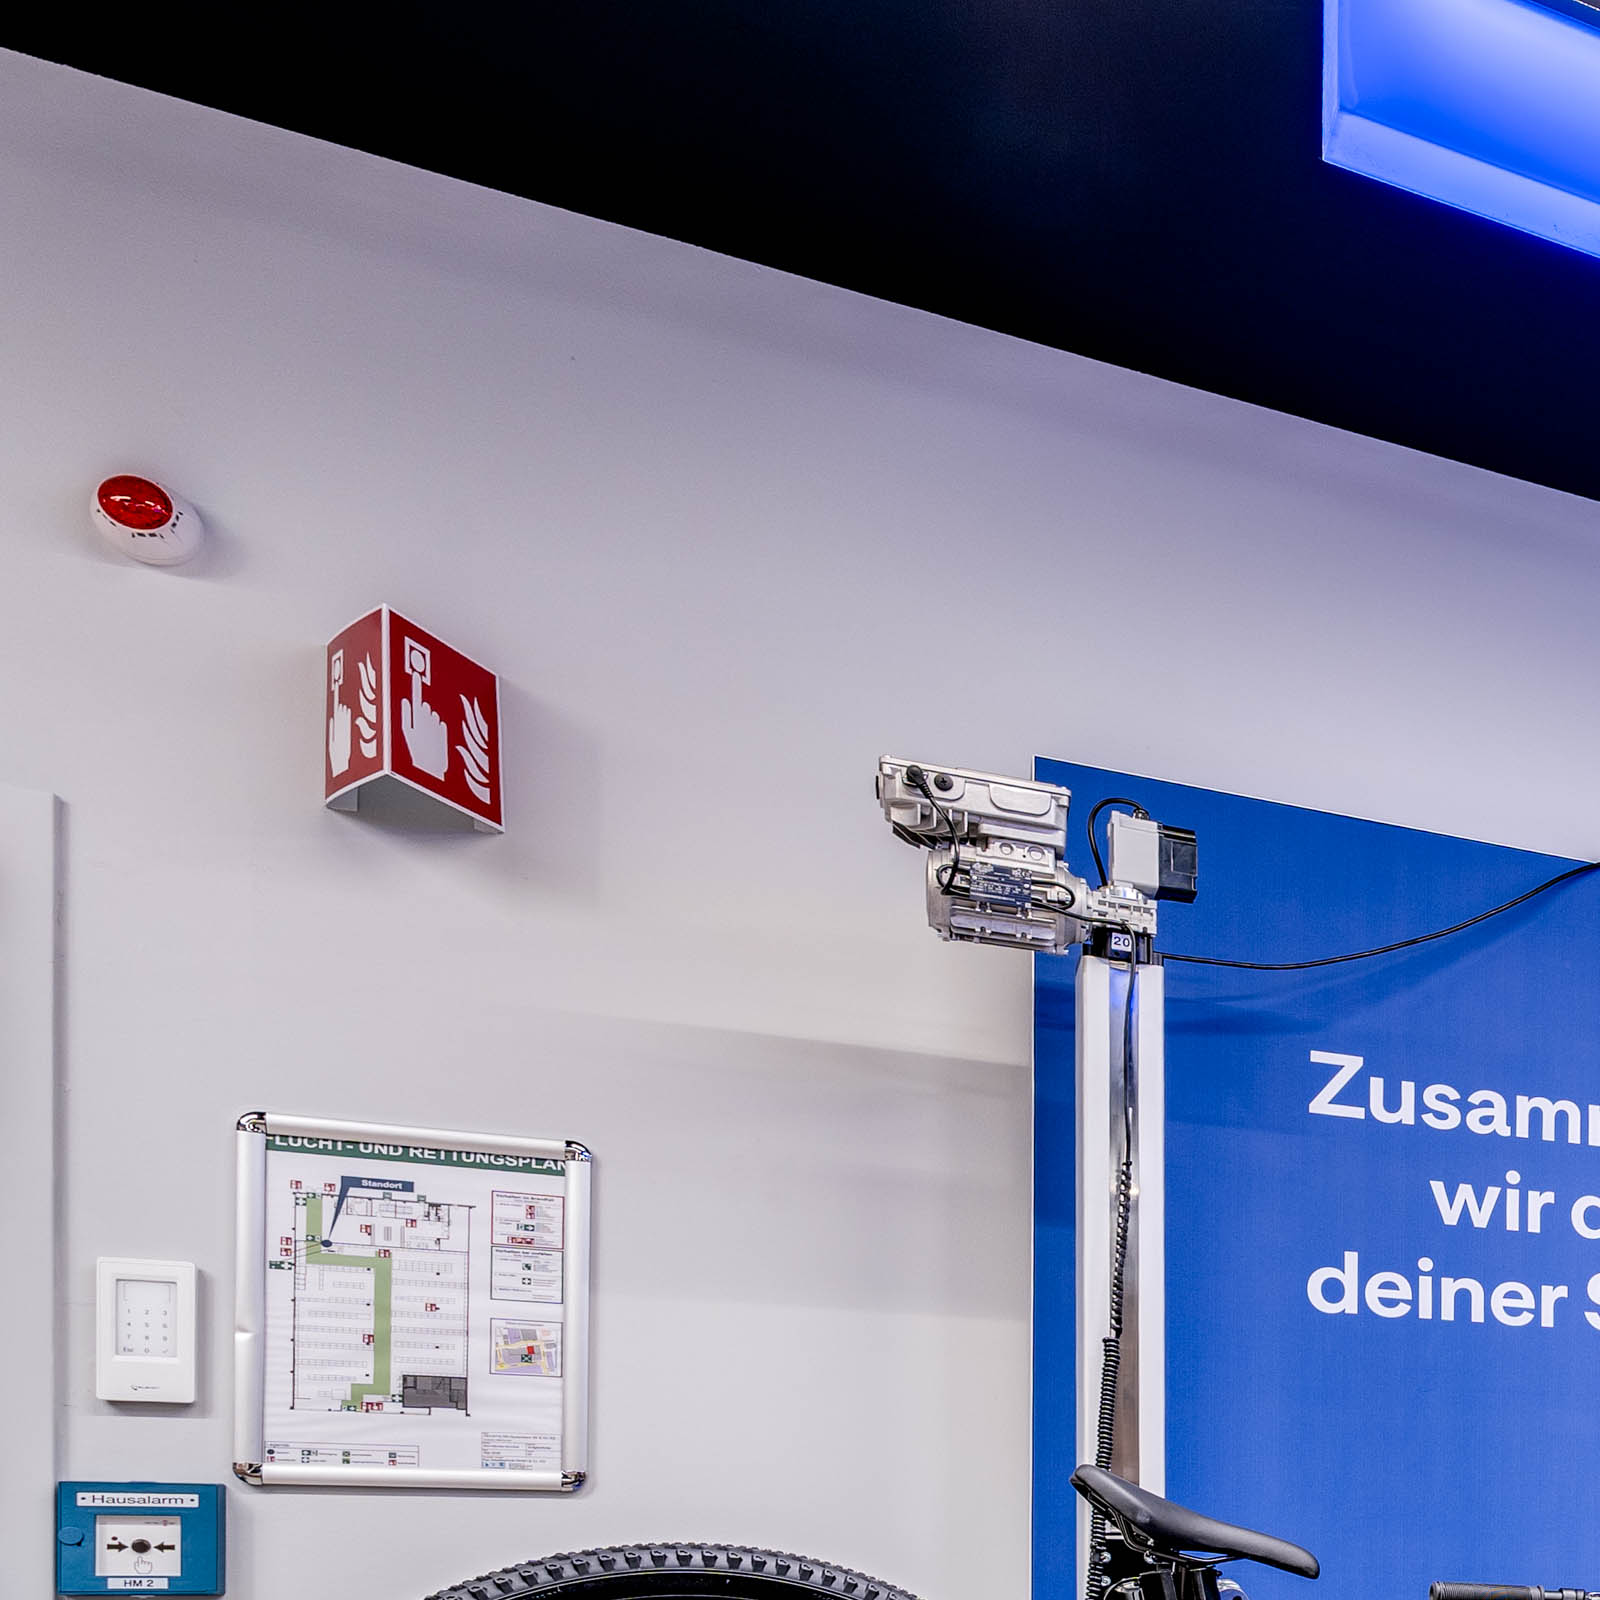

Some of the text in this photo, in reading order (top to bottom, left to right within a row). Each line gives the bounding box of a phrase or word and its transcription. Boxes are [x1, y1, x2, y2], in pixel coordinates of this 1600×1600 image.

[1113, 936, 1130, 948] 20
[266, 1135, 353, 1151] LUCHT-
[359, 1140, 403, 1157] UND
[361, 1179, 403, 1190] Standort
[1430, 1170, 1557, 1234] wir
[1307, 1252, 1568, 1328] deiner
[92, 1494, 184, 1505] Hausalarm
[123, 1579, 154, 1587] HM 2
